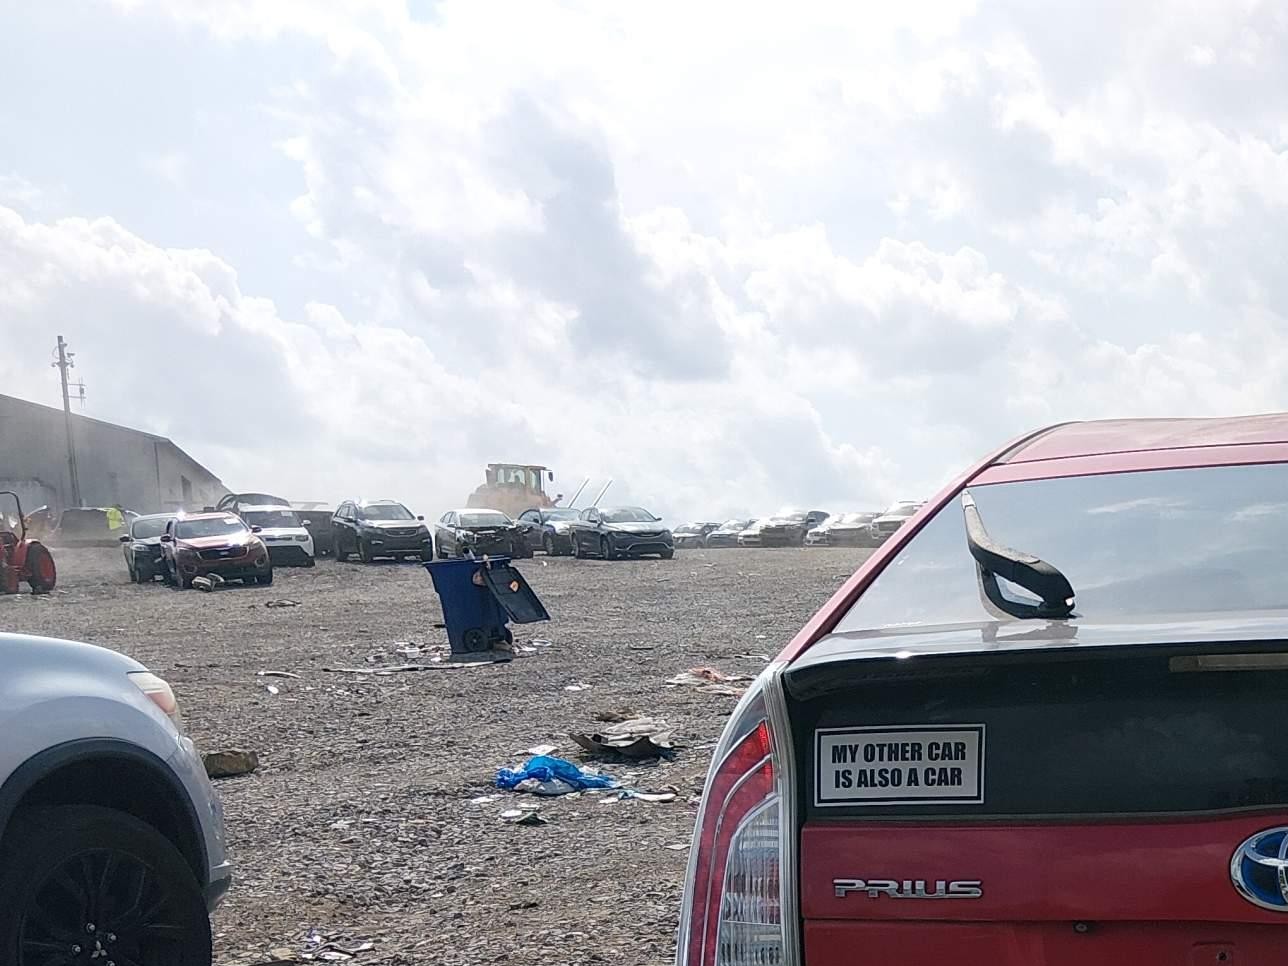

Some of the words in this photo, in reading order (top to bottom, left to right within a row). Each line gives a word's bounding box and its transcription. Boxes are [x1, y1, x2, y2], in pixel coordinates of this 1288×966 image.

[832, 744, 859, 763] MY
[863, 742, 923, 763] OTHER
[927, 741, 966, 761] CAR
[834, 769, 853, 788] IS
[857, 768, 903, 788] ALSO
[906, 767, 920, 786] A
[924, 767, 963, 787] CAR
[833, 878, 983, 899] PRIUS
